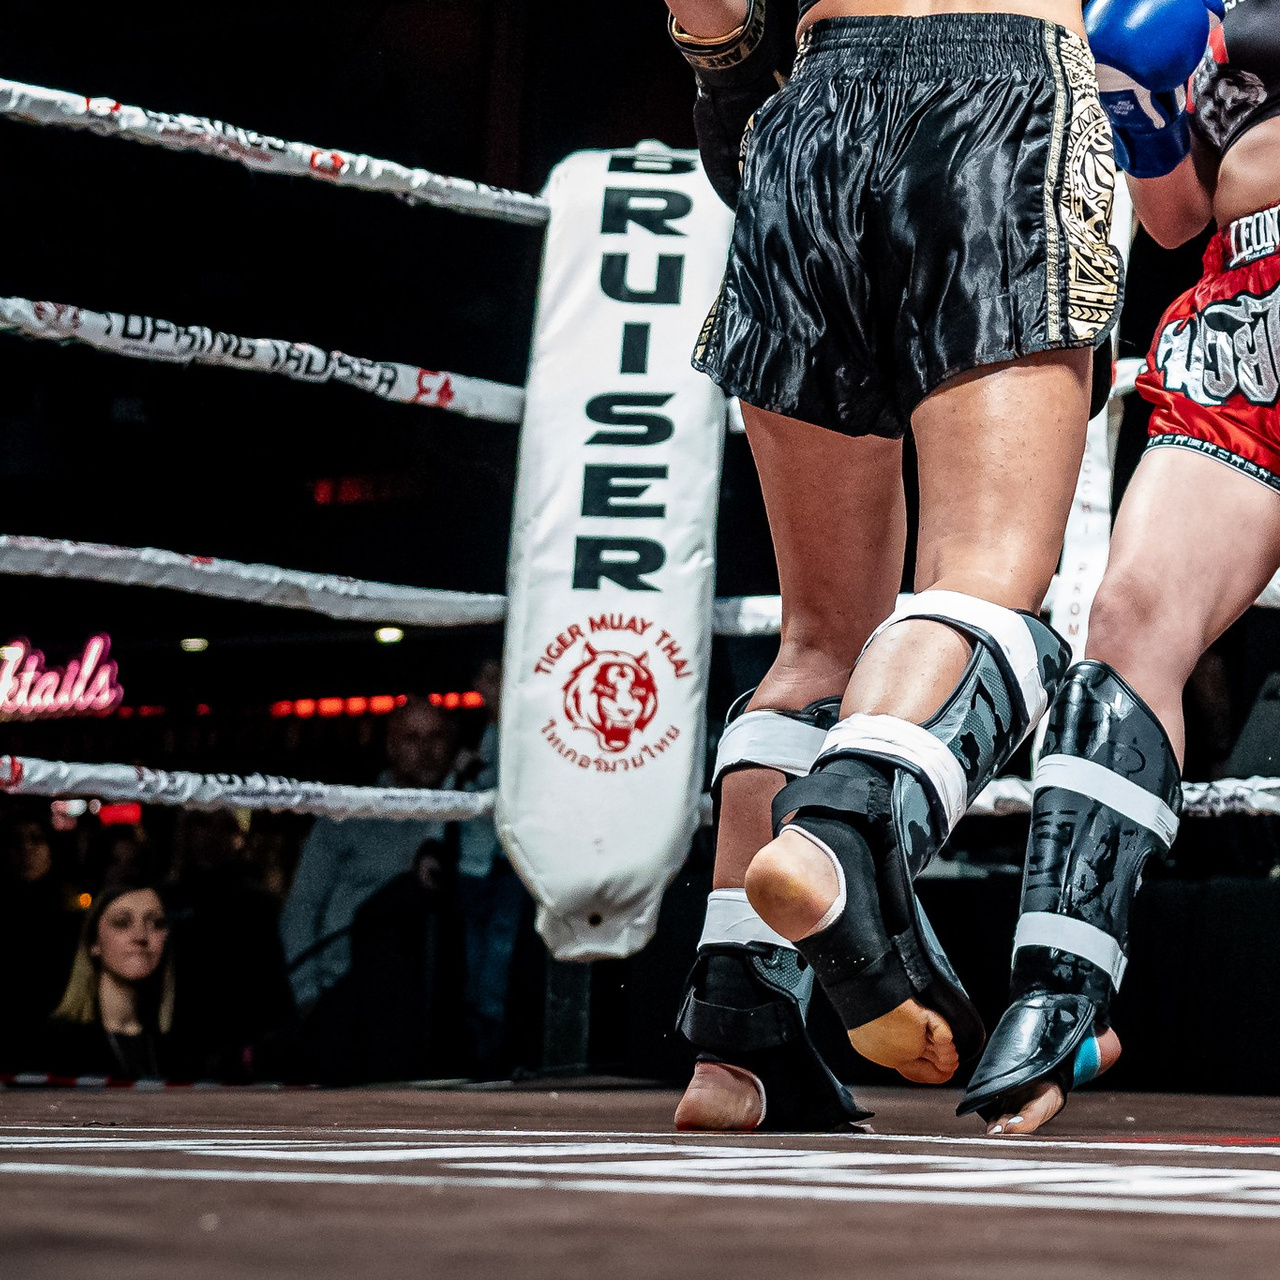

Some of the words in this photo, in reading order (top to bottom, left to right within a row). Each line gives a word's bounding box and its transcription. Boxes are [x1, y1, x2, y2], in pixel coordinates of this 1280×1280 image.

[534, 623, 585, 675] TIGER
[588, 612, 654, 636] MUAY
[655, 629, 693, 680] THAI
